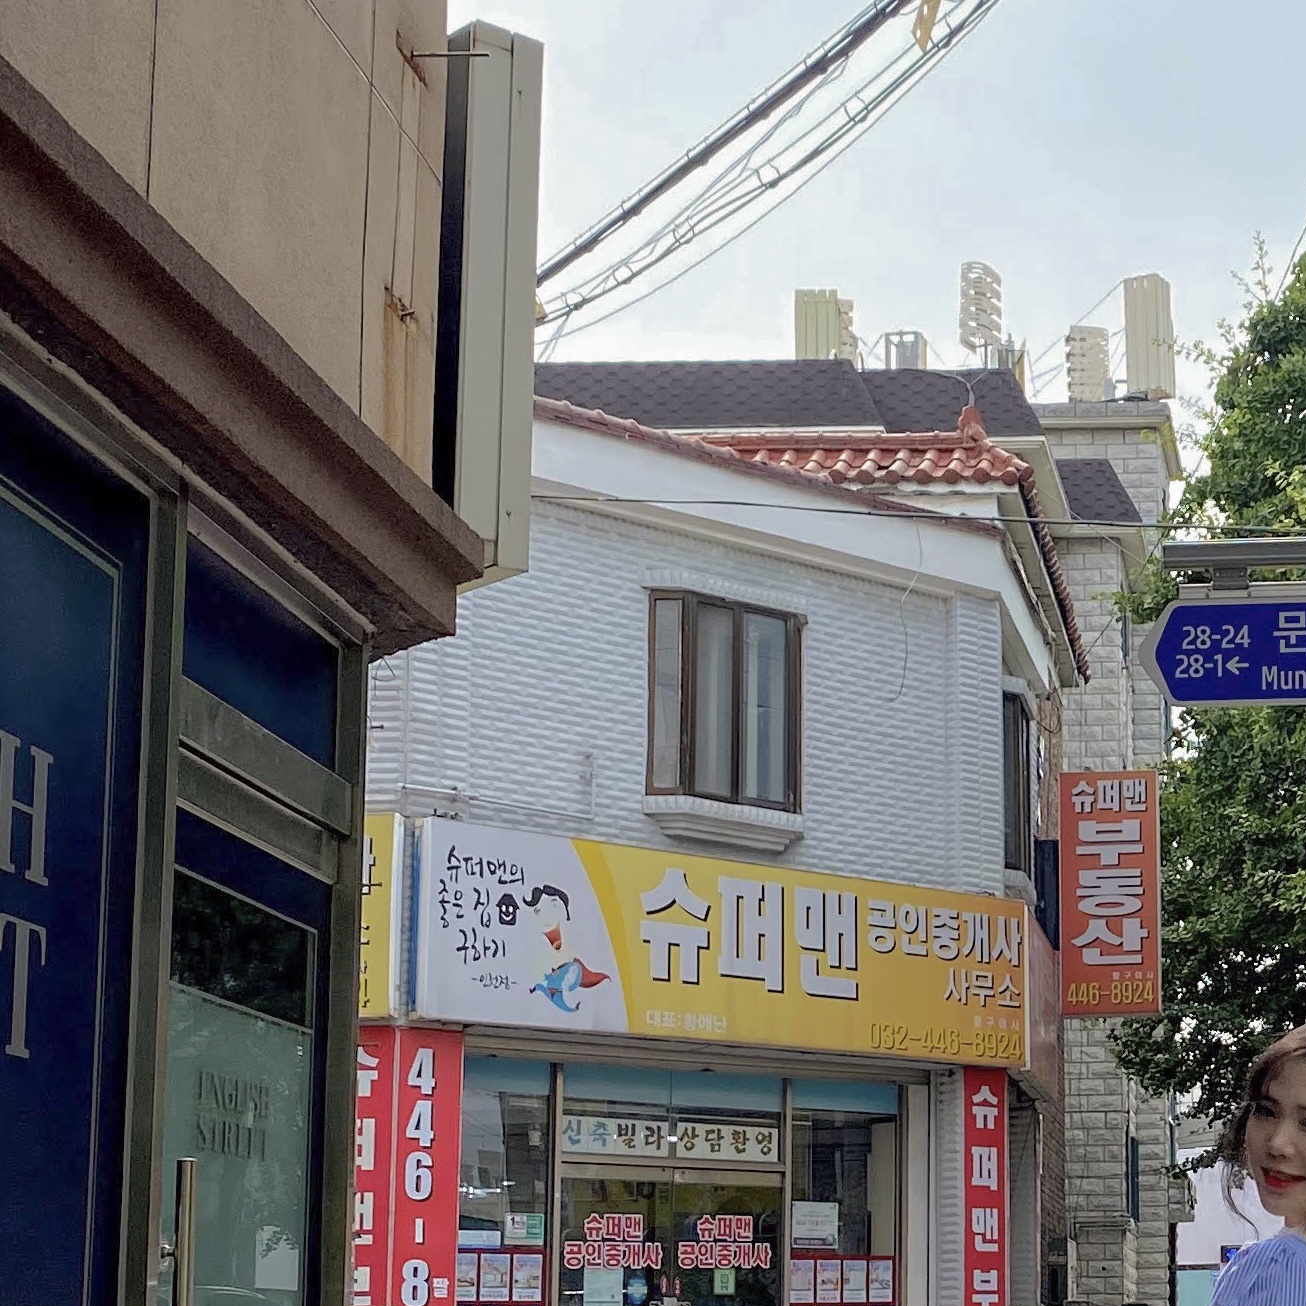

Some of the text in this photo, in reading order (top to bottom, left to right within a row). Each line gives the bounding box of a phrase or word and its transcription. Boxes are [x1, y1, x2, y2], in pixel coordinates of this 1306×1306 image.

[1182, 624, 1251, 650] 28-24
[1175, 654, 1224, 678] 28-1
[1071, 778, 1148, 813] 슈퍼맨
[446, 845, 525, 885] 슈퍼맨의
[438, 878, 492, 928] 좋은 집
[1070, 818, 1149, 966] 부동산
[456, 927, 506, 965] 구하기
[640, 868, 1023, 1001] 슈퍼맨 공인중개사
[943, 967, 1021, 1008] 사무소
[1067, 979, 1154, 1006] 446-8924
[869, 1020, 1023, 1061] 032-446-8924
[562, 1118, 773, 1156] 신축빌라 상담환영
[584, 1213, 643, 1241] 슈퍼맨
[697, 1214, 753, 1242] 슈퍼맨
[564, 1241, 662, 1269] 공인중개사
[677, 1242, 771, 1269] 공인중개사
